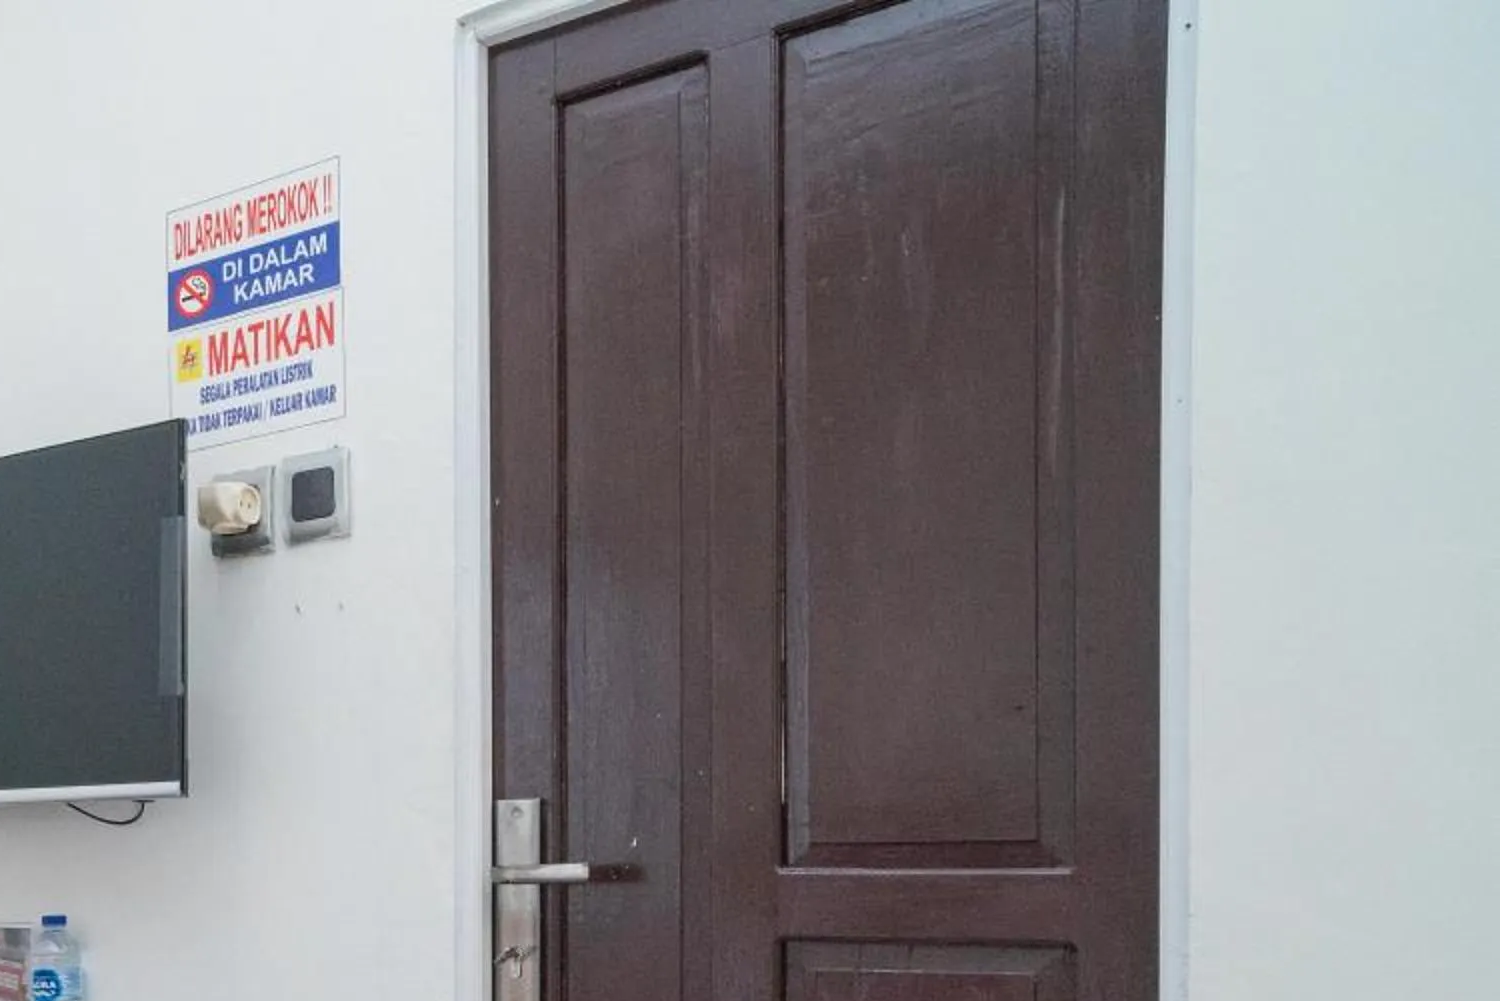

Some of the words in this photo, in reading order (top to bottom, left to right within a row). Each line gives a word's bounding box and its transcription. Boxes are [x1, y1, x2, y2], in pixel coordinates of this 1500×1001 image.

[174, 204, 243, 261] DILARANG
[247, 178, 320, 238] MEROKOK
[223, 257, 243, 283] DI
[250, 232, 328, 273] DALAM
[233, 263, 316, 305] KAMAR
[207, 301, 336, 378] MATIKAN
